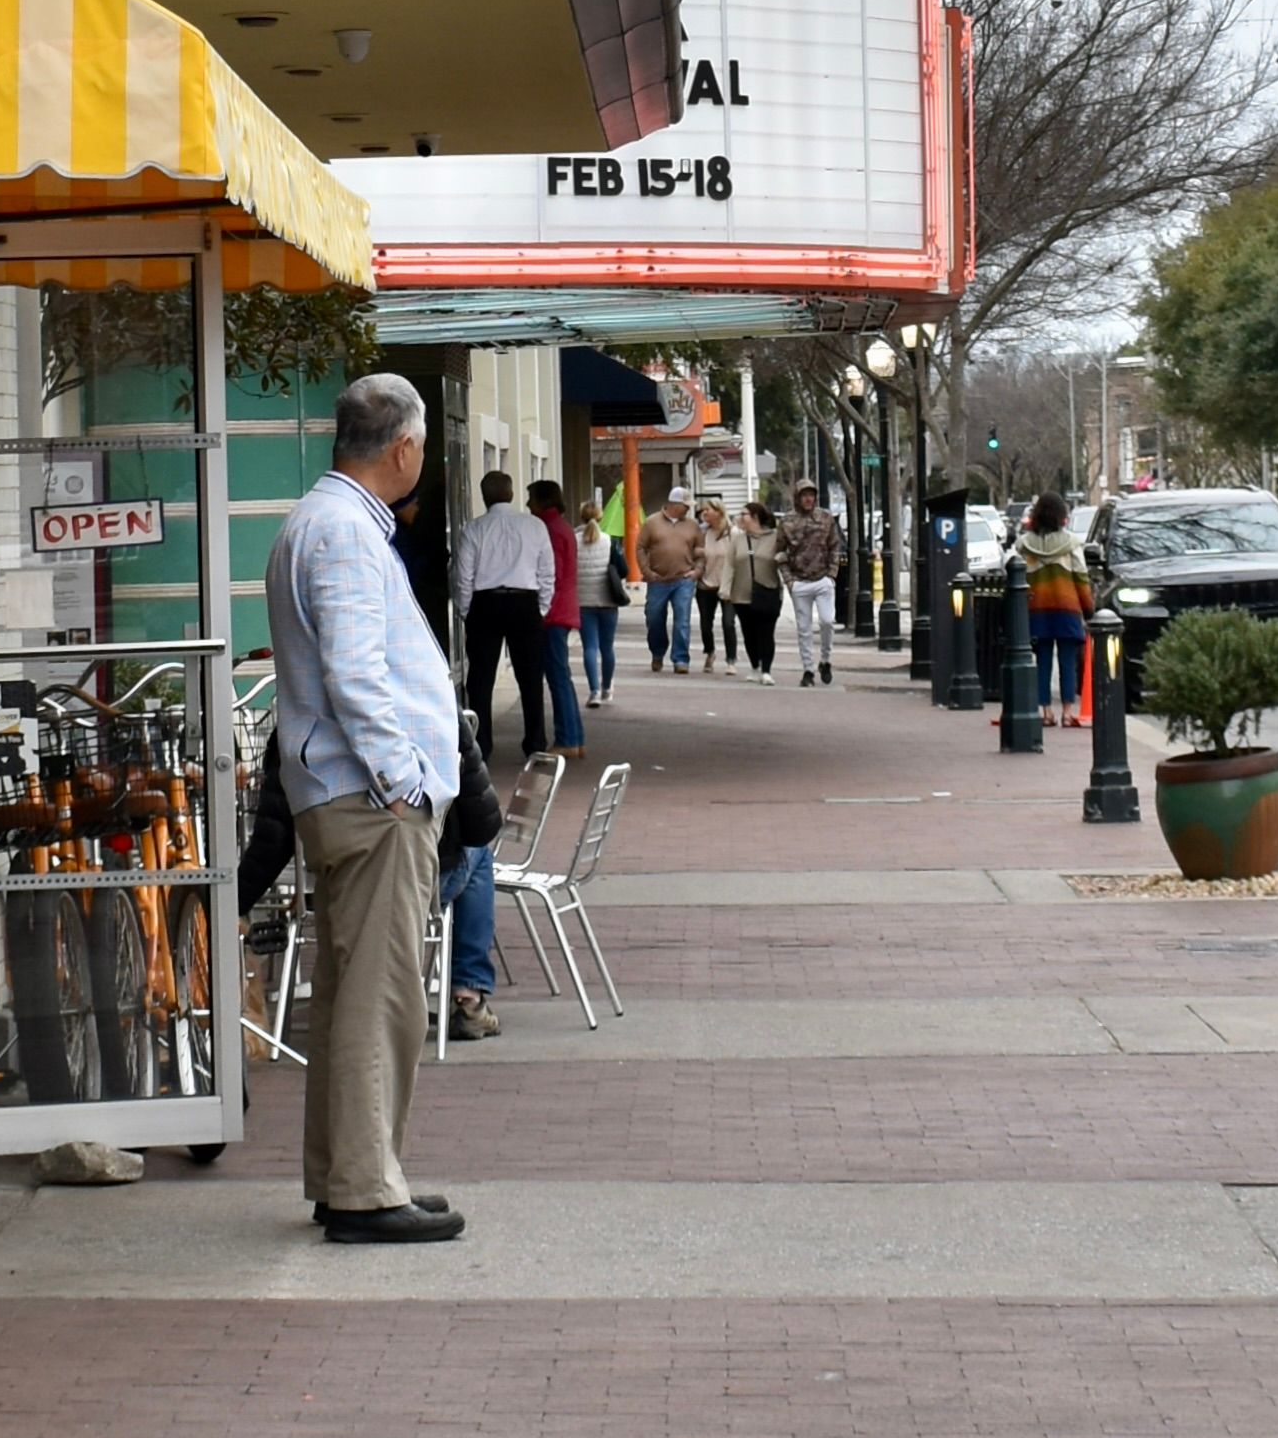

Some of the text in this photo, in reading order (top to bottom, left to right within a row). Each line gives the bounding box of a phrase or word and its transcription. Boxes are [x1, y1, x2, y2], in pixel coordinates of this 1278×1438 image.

[682, 59, 749, 106] AL
[547, 155, 732, 201] FEB 15-18
[43, 510, 152, 544] OPEN
[941, 520, 954, 539] P
